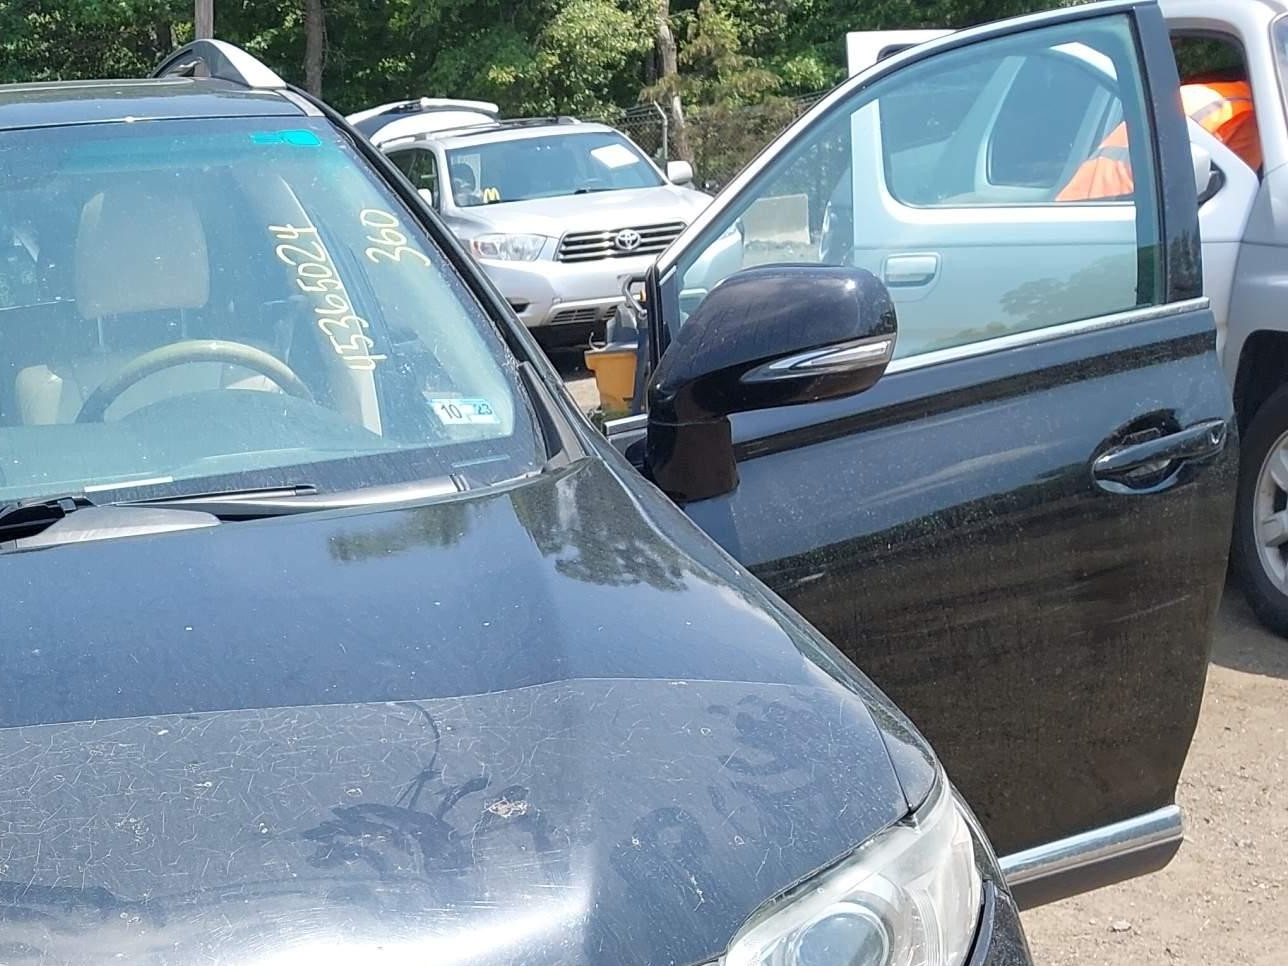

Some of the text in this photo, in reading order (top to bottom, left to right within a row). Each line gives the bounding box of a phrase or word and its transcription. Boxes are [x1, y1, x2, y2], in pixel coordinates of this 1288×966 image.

[360, 209, 431, 267] 360
[268, 223, 388, 370] 45365024
[440, 404, 463, 419] 10
